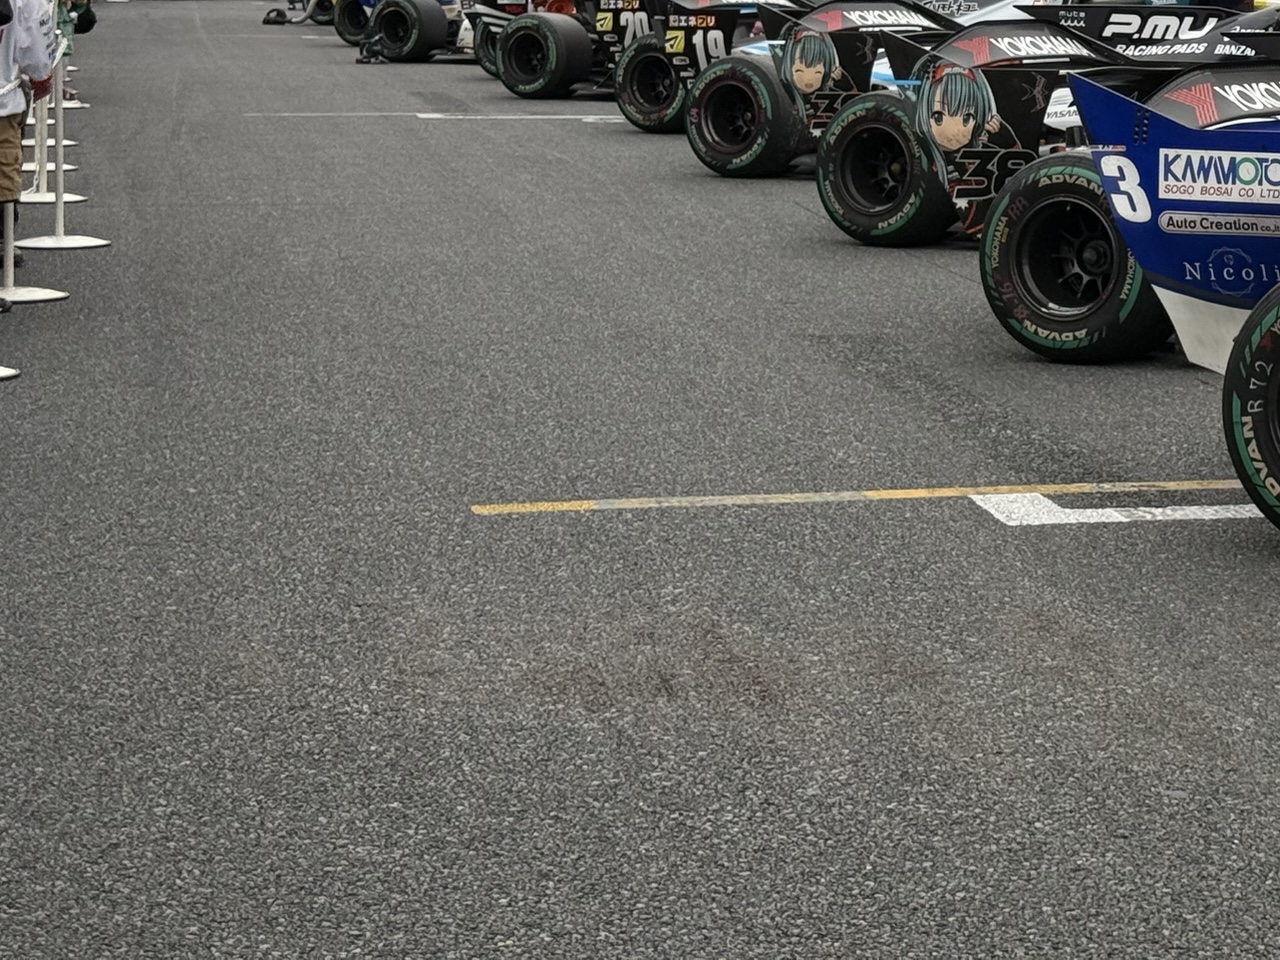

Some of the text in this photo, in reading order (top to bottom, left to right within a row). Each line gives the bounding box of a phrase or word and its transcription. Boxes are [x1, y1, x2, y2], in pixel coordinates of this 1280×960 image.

[620, 11, 649, 47] 20
[843, 10, 938, 28] YOKOHAMA
[692, 29, 727, 72] 19
[989, 35, 1097, 58] YOKOHAMA
[1115, 43, 1209, 57] RACING PADS
[829, 109, 867, 146] ADVAN
[1038, 174, 1104, 195] ADVAN
[1100, 154, 1152, 223] 3
[1164, 184, 1280, 199] SOGO BOSAI CO LTD
[878, 192, 916, 230] ADVAN
[1166, 215, 1197, 230] Auto
[1199, 217, 1259, 232] Creation
[991, 216, 1009, 269] YOKOHAMA
[1023, 319, 1089, 342] ADVAN
